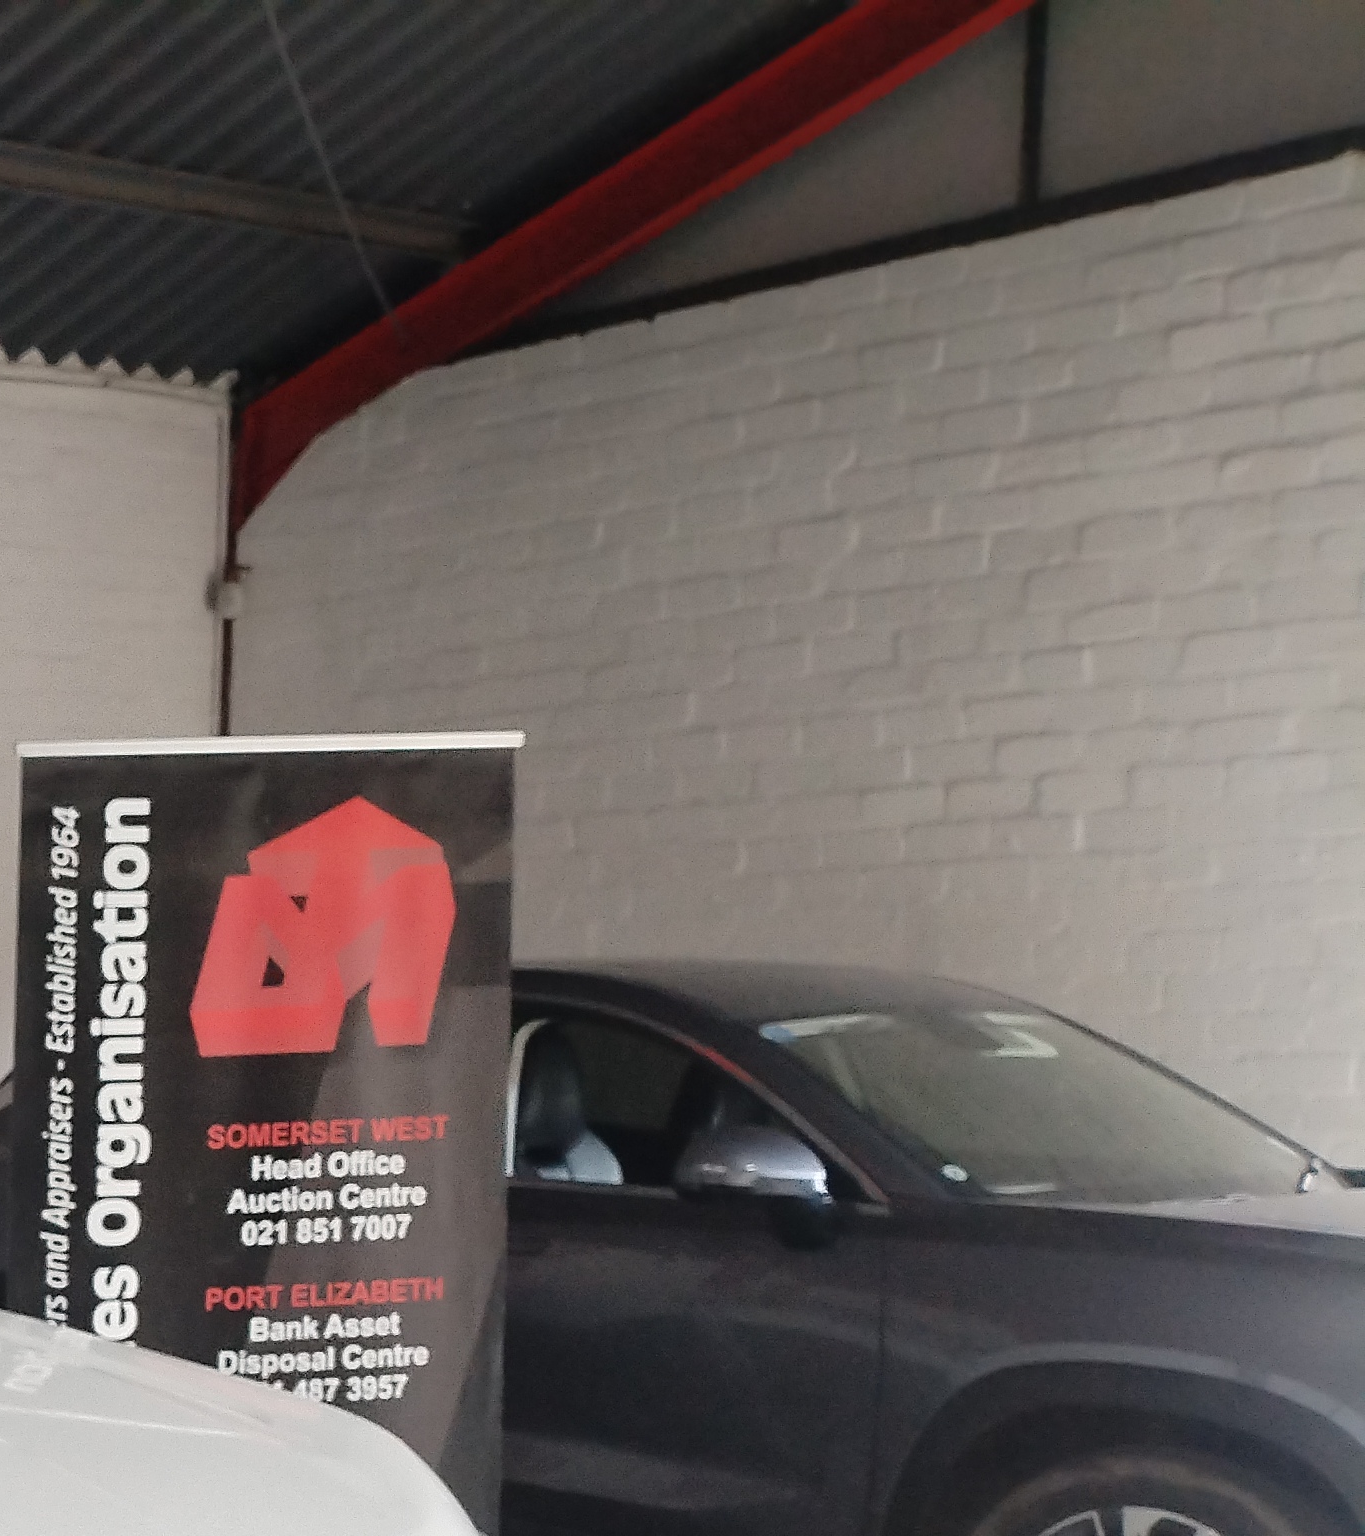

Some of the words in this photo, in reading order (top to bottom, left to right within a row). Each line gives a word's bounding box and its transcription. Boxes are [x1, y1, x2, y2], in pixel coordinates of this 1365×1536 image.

[50, 805, 80, 880] 1964
[45, 885, 79, 1054] Established
[85, 796, 152, 1247] Organisation
[206, 1117, 365, 1150] SOMERSET
[370, 1113, 449, 1143] WEST
[40, 1076, 77, 1228] Appraisers
[251, 1152, 322, 1181] Head
[327, 1150, 406, 1178] Office
[226, 1185, 333, 1214] Auction
[339, 1182, 428, 1210] Centre
[240, 1218, 288, 1246] 021
[295, 1216, 343, 1244] 851
[350, 1213, 412, 1241] 7007
[40, 1230, 69, 1289] and
[204, 1283, 284, 1312] PORT
[290, 1276, 444, 1308] ELIZABETH
[249, 1314, 319, 1343] Bank
[323, 1311, 402, 1339] Asset
[218, 1345, 336, 1379] Disposal
[341, 1343, 430, 1370] Centre
[346, 1373, 409, 1401] 3957
